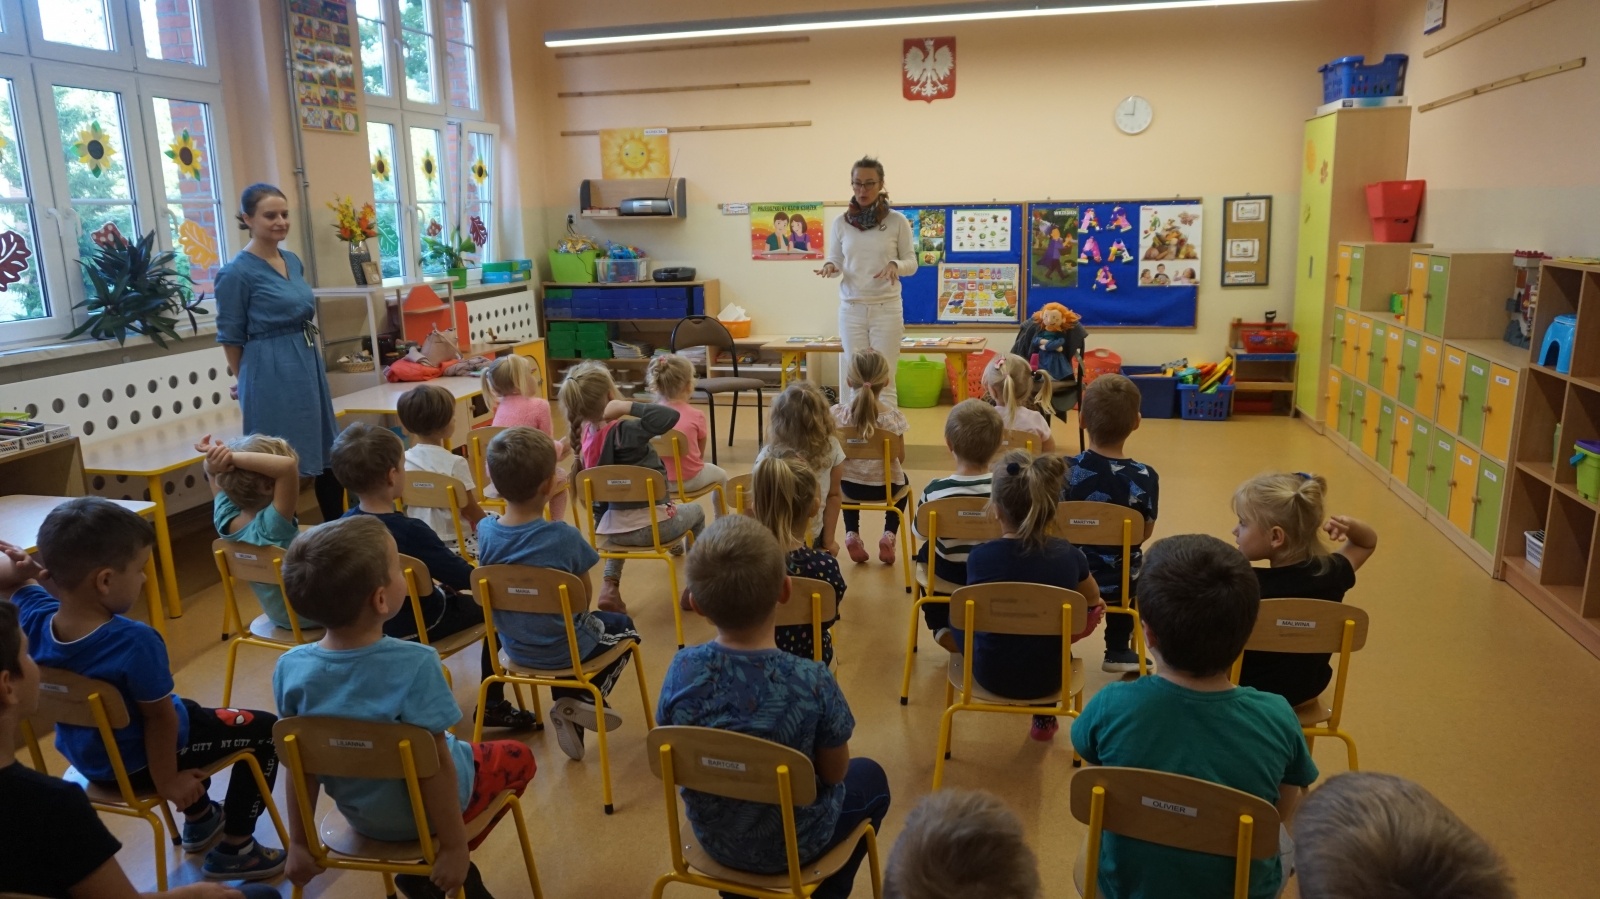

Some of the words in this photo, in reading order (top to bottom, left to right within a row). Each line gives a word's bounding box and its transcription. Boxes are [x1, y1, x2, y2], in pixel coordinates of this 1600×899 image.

[192, 742, 213, 752] CITY
[221, 739, 232, 748] NY
[234, 738, 251, 747] CITY
[336, 740, 366, 748] LILIANNA
[708, 759, 740, 769] BARTOSZ
[1152, 801, 1186, 813] OLIVIER
